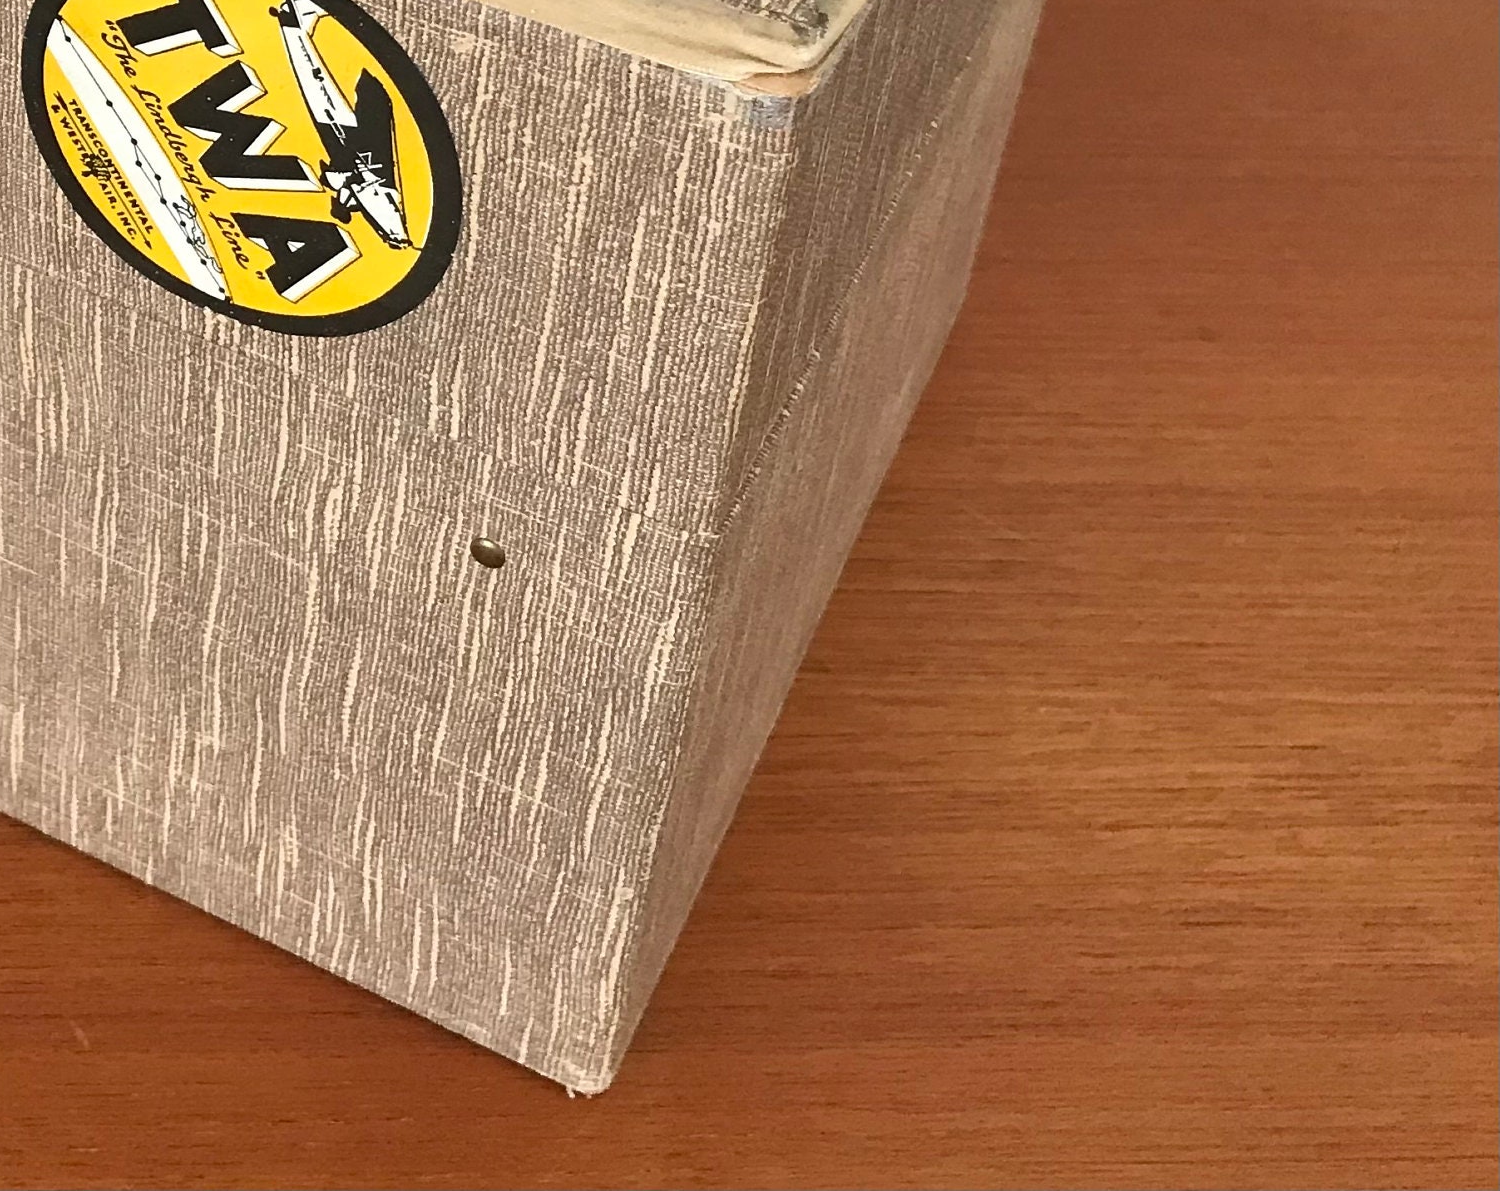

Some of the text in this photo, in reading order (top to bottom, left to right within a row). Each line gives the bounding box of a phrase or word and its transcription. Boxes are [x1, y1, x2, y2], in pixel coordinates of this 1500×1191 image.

[60, 117, 97, 174] WESTE
[98, 183, 118, 209] AIR,
[117, 211, 137, 240] INC.
[68, 98, 154, 235] TRANSCONTINENTAL
[130, 84, 217, 202] Lindbergh
